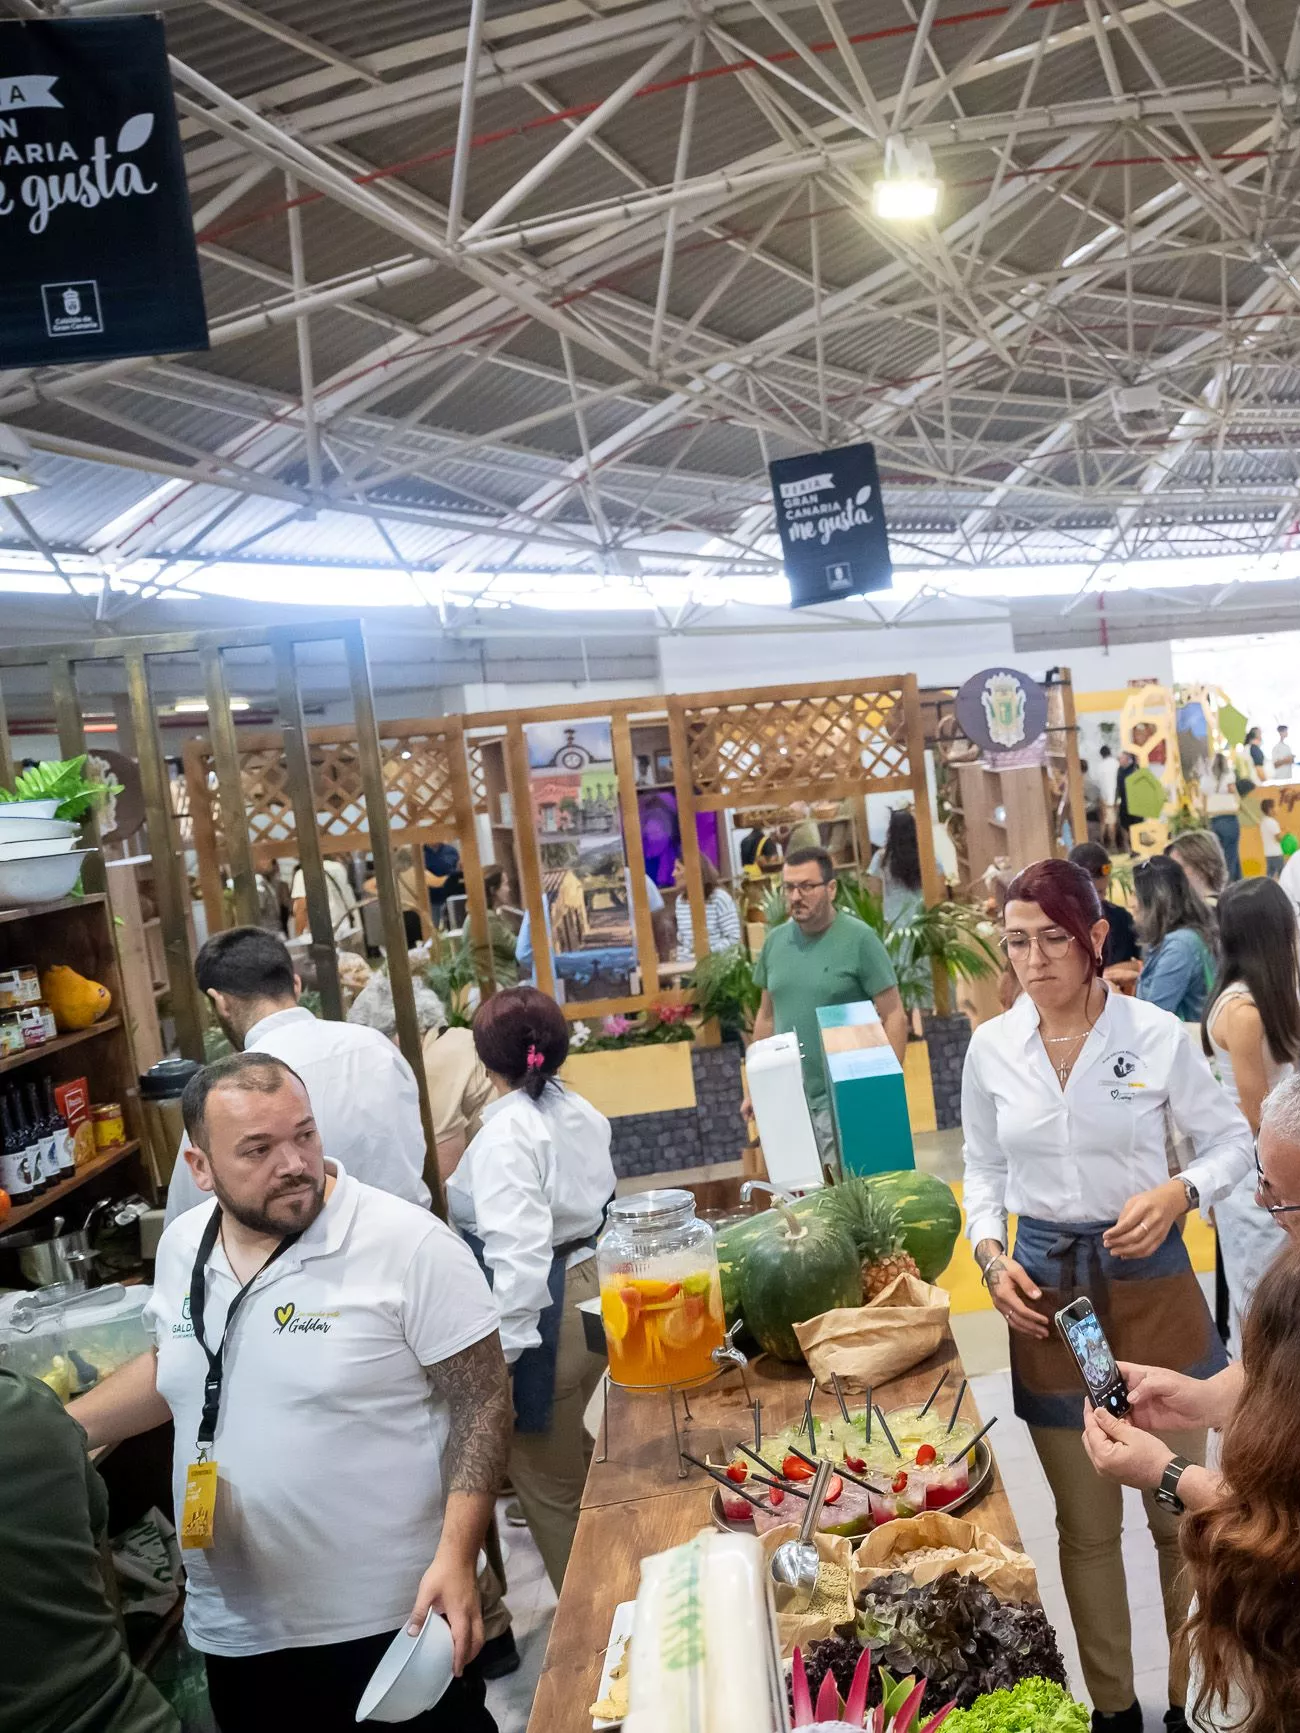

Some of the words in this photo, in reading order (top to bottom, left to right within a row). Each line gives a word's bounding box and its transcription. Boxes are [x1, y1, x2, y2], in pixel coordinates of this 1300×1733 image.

[0, 141, 79, 165] ARIA
[21, 137, 157, 234] gusta
[783, 493, 818, 509] GRAN
[785, 501, 842, 520] CANARIA
[788, 520, 818, 542] me
[818, 497, 874, 545] gusta
[172, 1323, 195, 1333] GALD
[289, 1317, 332, 1334] Gáldar
